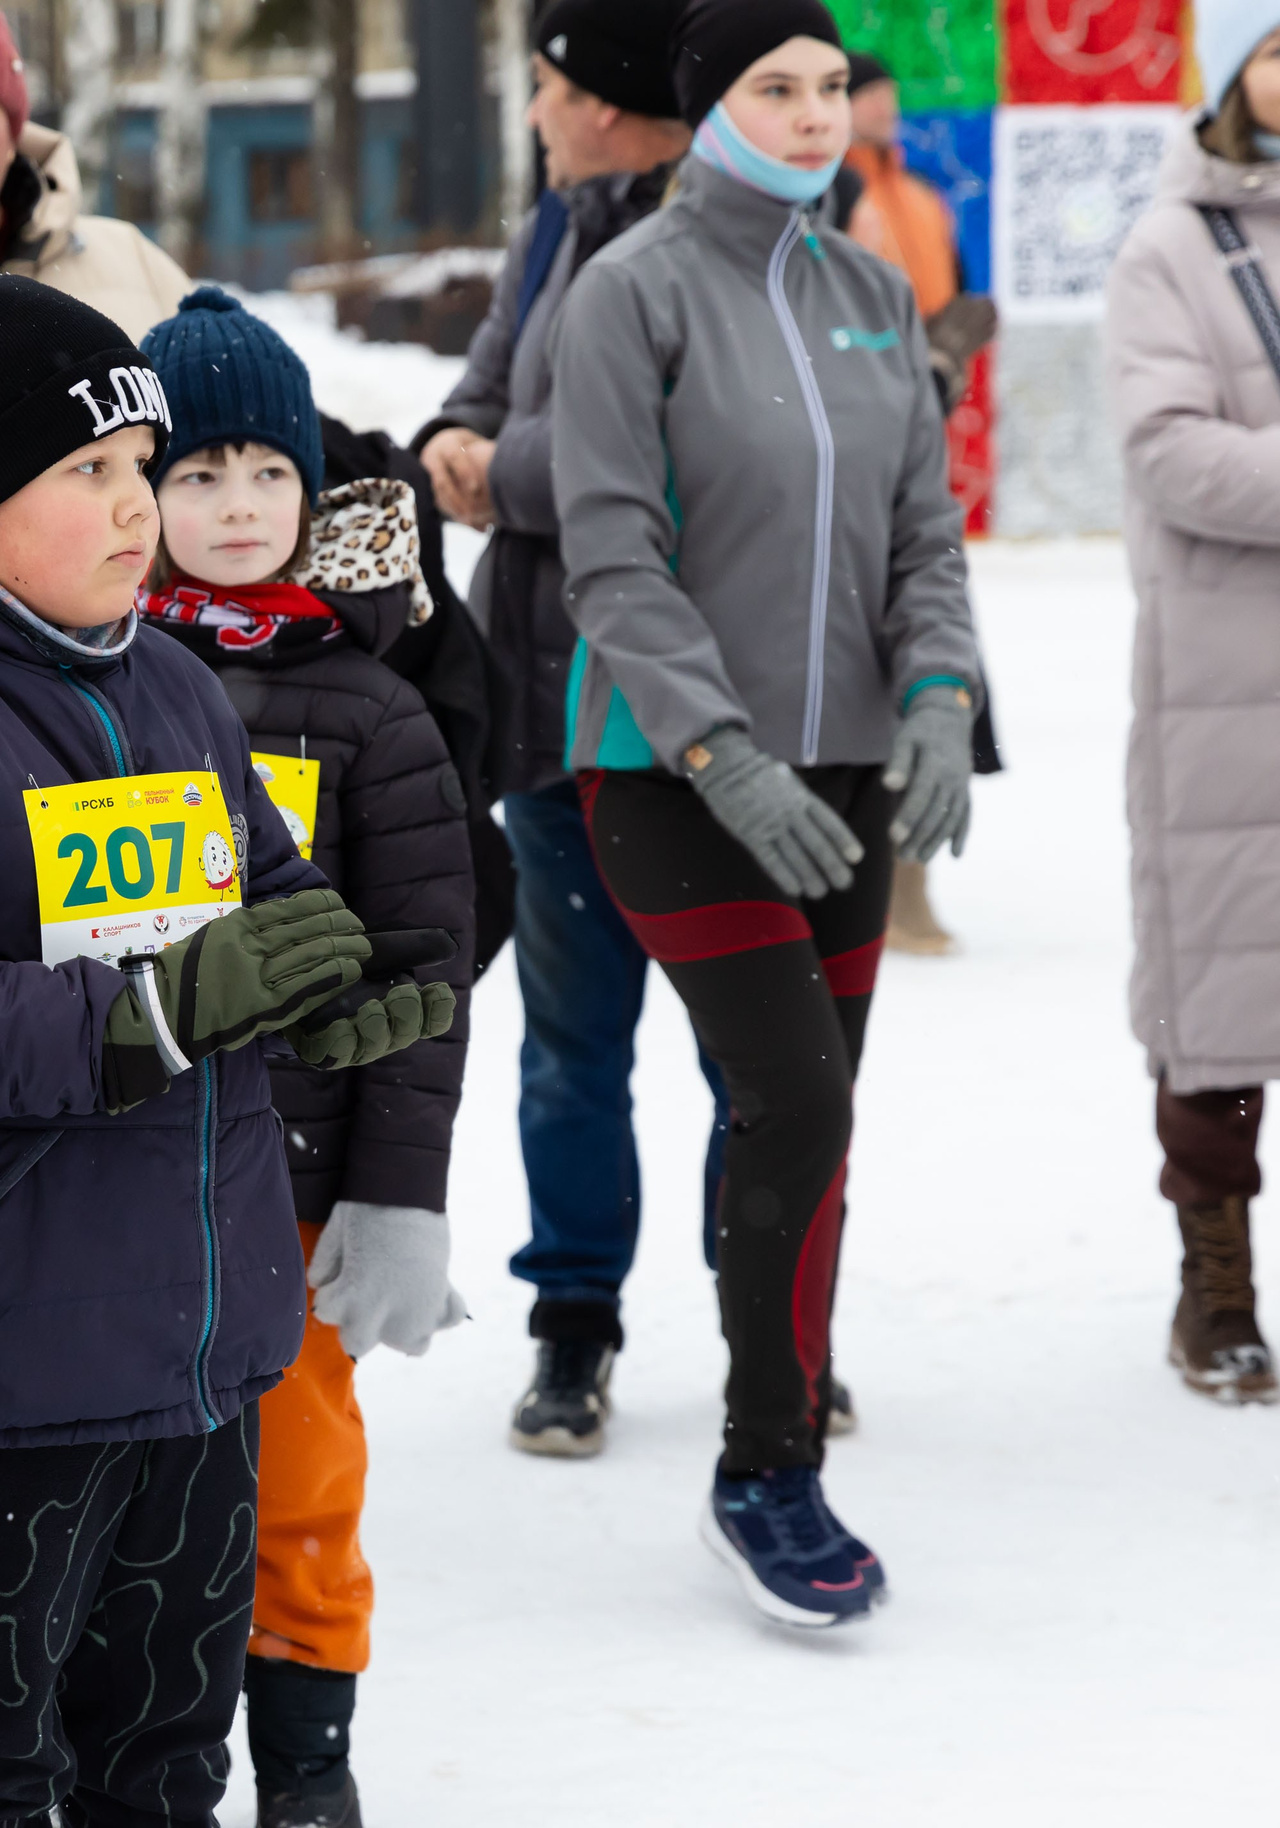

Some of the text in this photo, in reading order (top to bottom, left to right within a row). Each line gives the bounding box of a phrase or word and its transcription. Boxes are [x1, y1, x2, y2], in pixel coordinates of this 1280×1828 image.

[81, 797, 114, 811] РСХБ
[145, 795, 169, 805] КУБОК
[57, 821, 185, 908] 207
[103, 922, 141, 932] КАЛАШНИКОВ
[103, 930, 121, 938] СПОРТ
